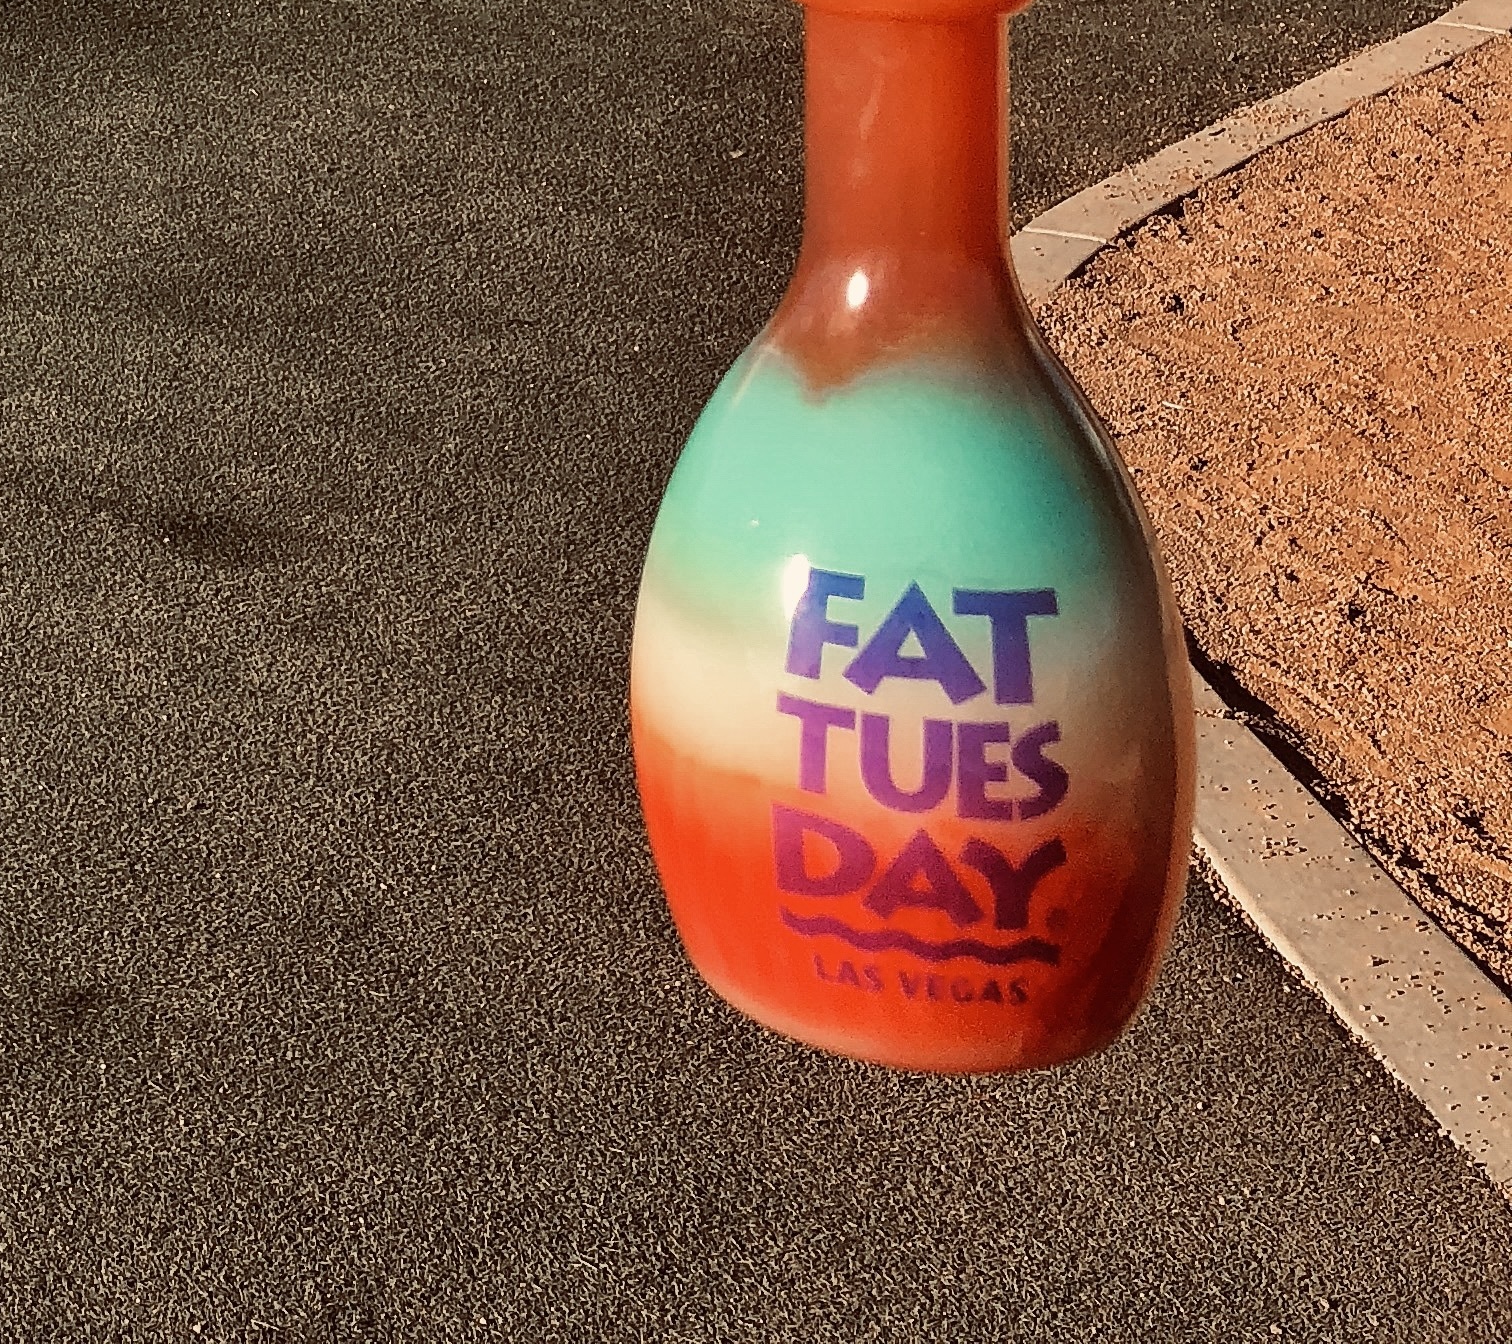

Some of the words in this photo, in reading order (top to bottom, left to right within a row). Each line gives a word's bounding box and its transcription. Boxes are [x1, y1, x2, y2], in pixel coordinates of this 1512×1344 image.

[784, 566, 1061, 706] FAT
[775, 690, 1070, 822] TUES
[813, 953, 884, 994] LAS
[898, 970, 1029, 1005] VEGAS
